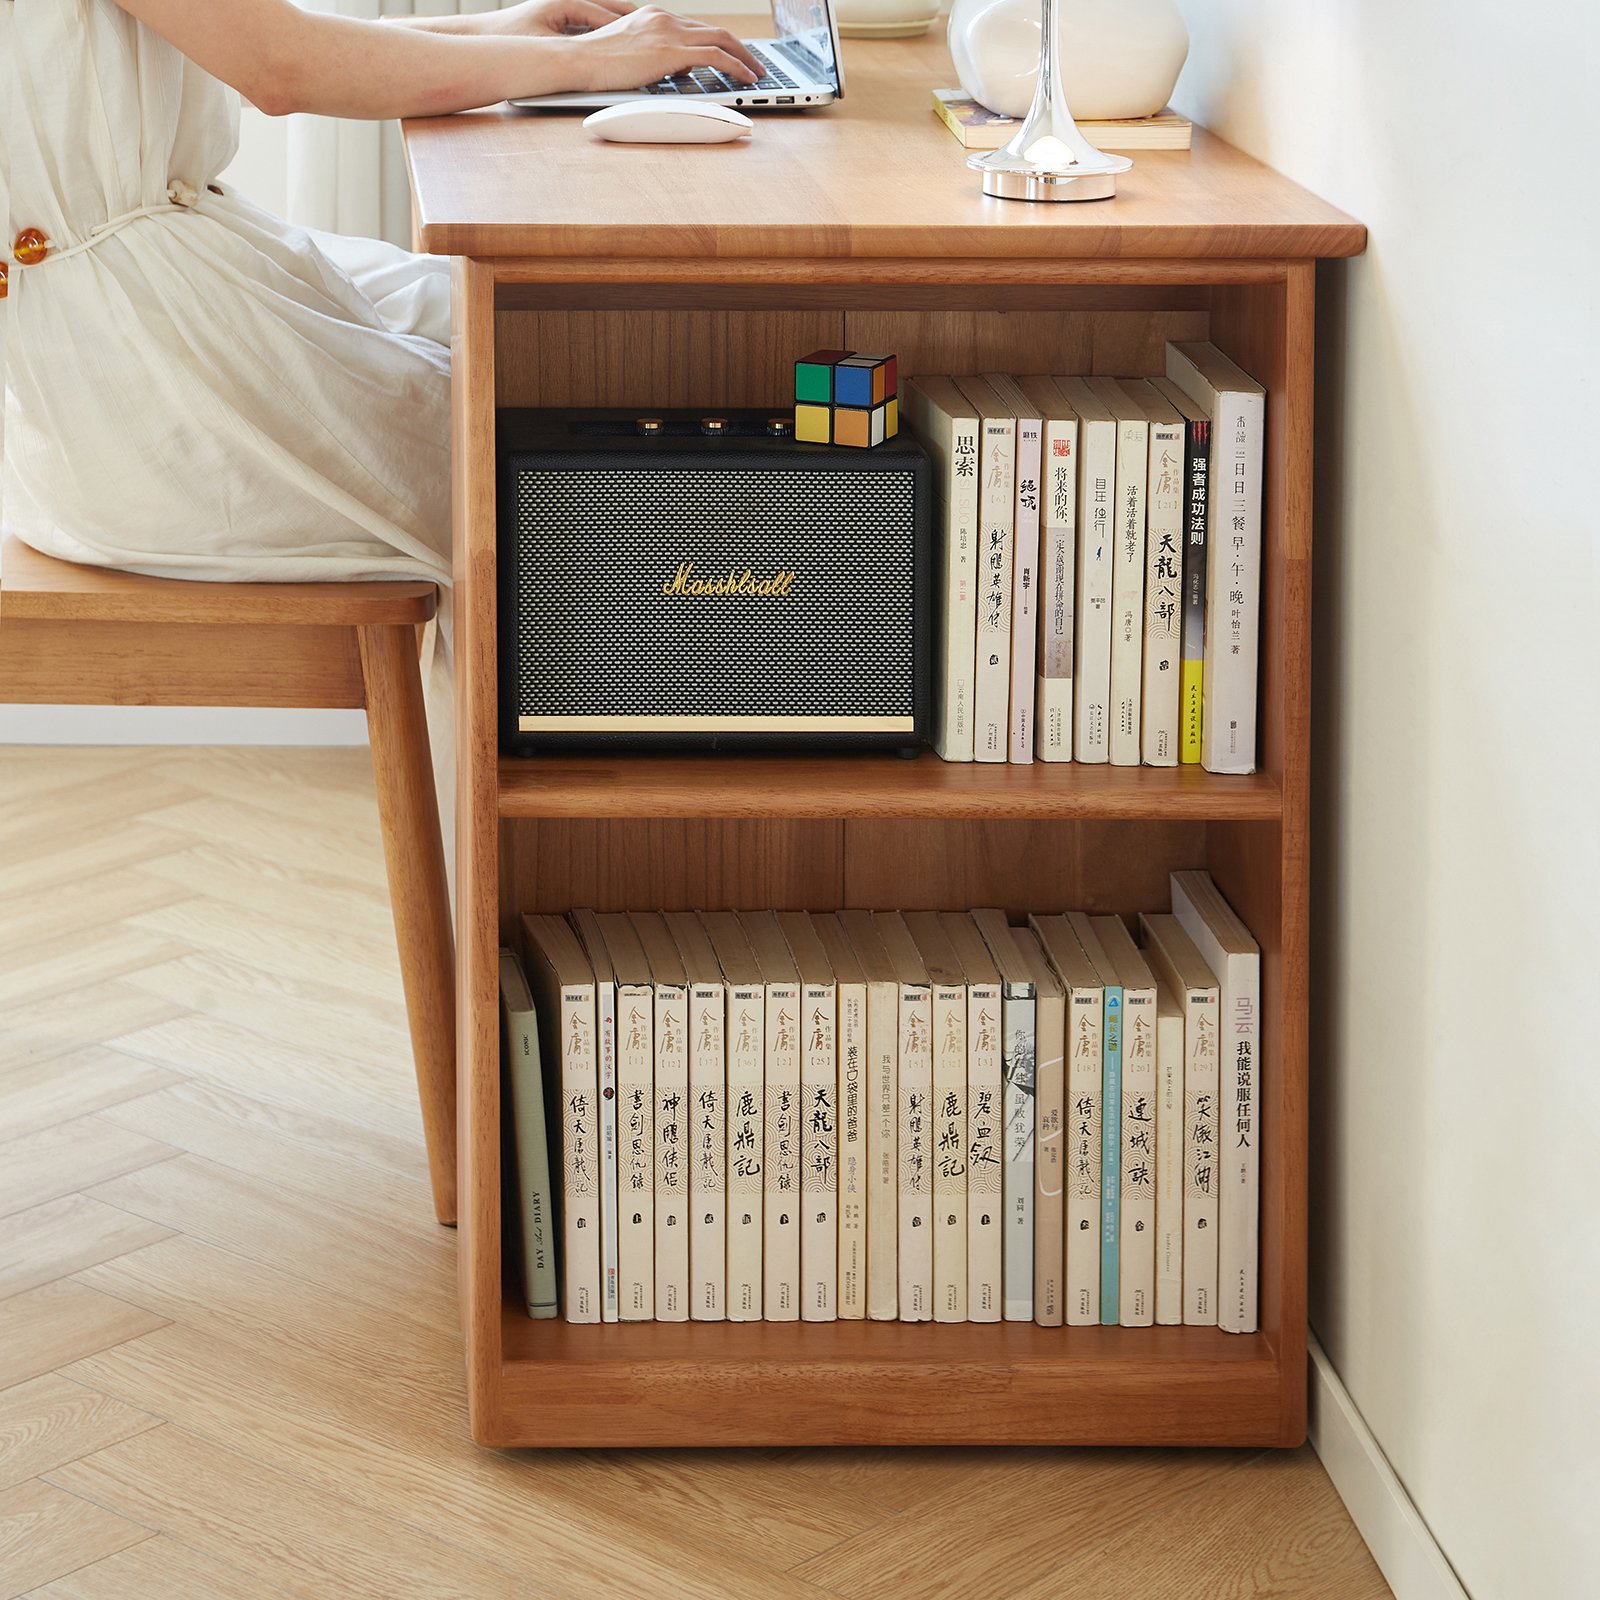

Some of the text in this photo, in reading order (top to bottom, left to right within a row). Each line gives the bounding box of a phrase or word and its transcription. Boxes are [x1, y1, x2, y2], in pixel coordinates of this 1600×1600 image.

[955, 435, 976, 477] 思索
[987, 444, 1008, 489] 金庸
[1156, 449, 1177, 495] 金庸
[959, 498, 970, 524] SUO
[1190, 458, 1206, 545] 强者成功法则
[1125, 485, 1138, 563] 活着活着就老了
[1231, 609, 1241, 654] 叶怡兰 著
[567, 1012, 587, 1055] 金庸
[626, 1006, 646, 1051] 金庸
[660, 1010, 680, 1054] 金庸
[697, 1008, 717, 1052] 金庸
[736, 1009, 756, 1053] 金庸
[774, 1008, 794, 1052] 金庸
[809, 1008, 829, 1051] 金庸
[905, 1010, 924, 1054] 金庸
[942, 1010, 961, 1054] 金庸
[975, 1008, 995, 1052] 金庸
[1075, 1014, 1095, 1058] 金庸
[1130, 1014, 1150, 1058] 金庸
[1193, 1013, 1214, 1057] 金庸
[1235, 998, 1253, 1034] 马云
[847, 1046, 858, 1142] 装在口袋里的爸爸
[882, 1055, 891, 1139] 我与世界只差一个你
[1236, 1041, 1251, 1148] 我能说服任何人
[533, 1191, 541, 1223] DIARY
[536, 1248, 544, 1269] DAY
